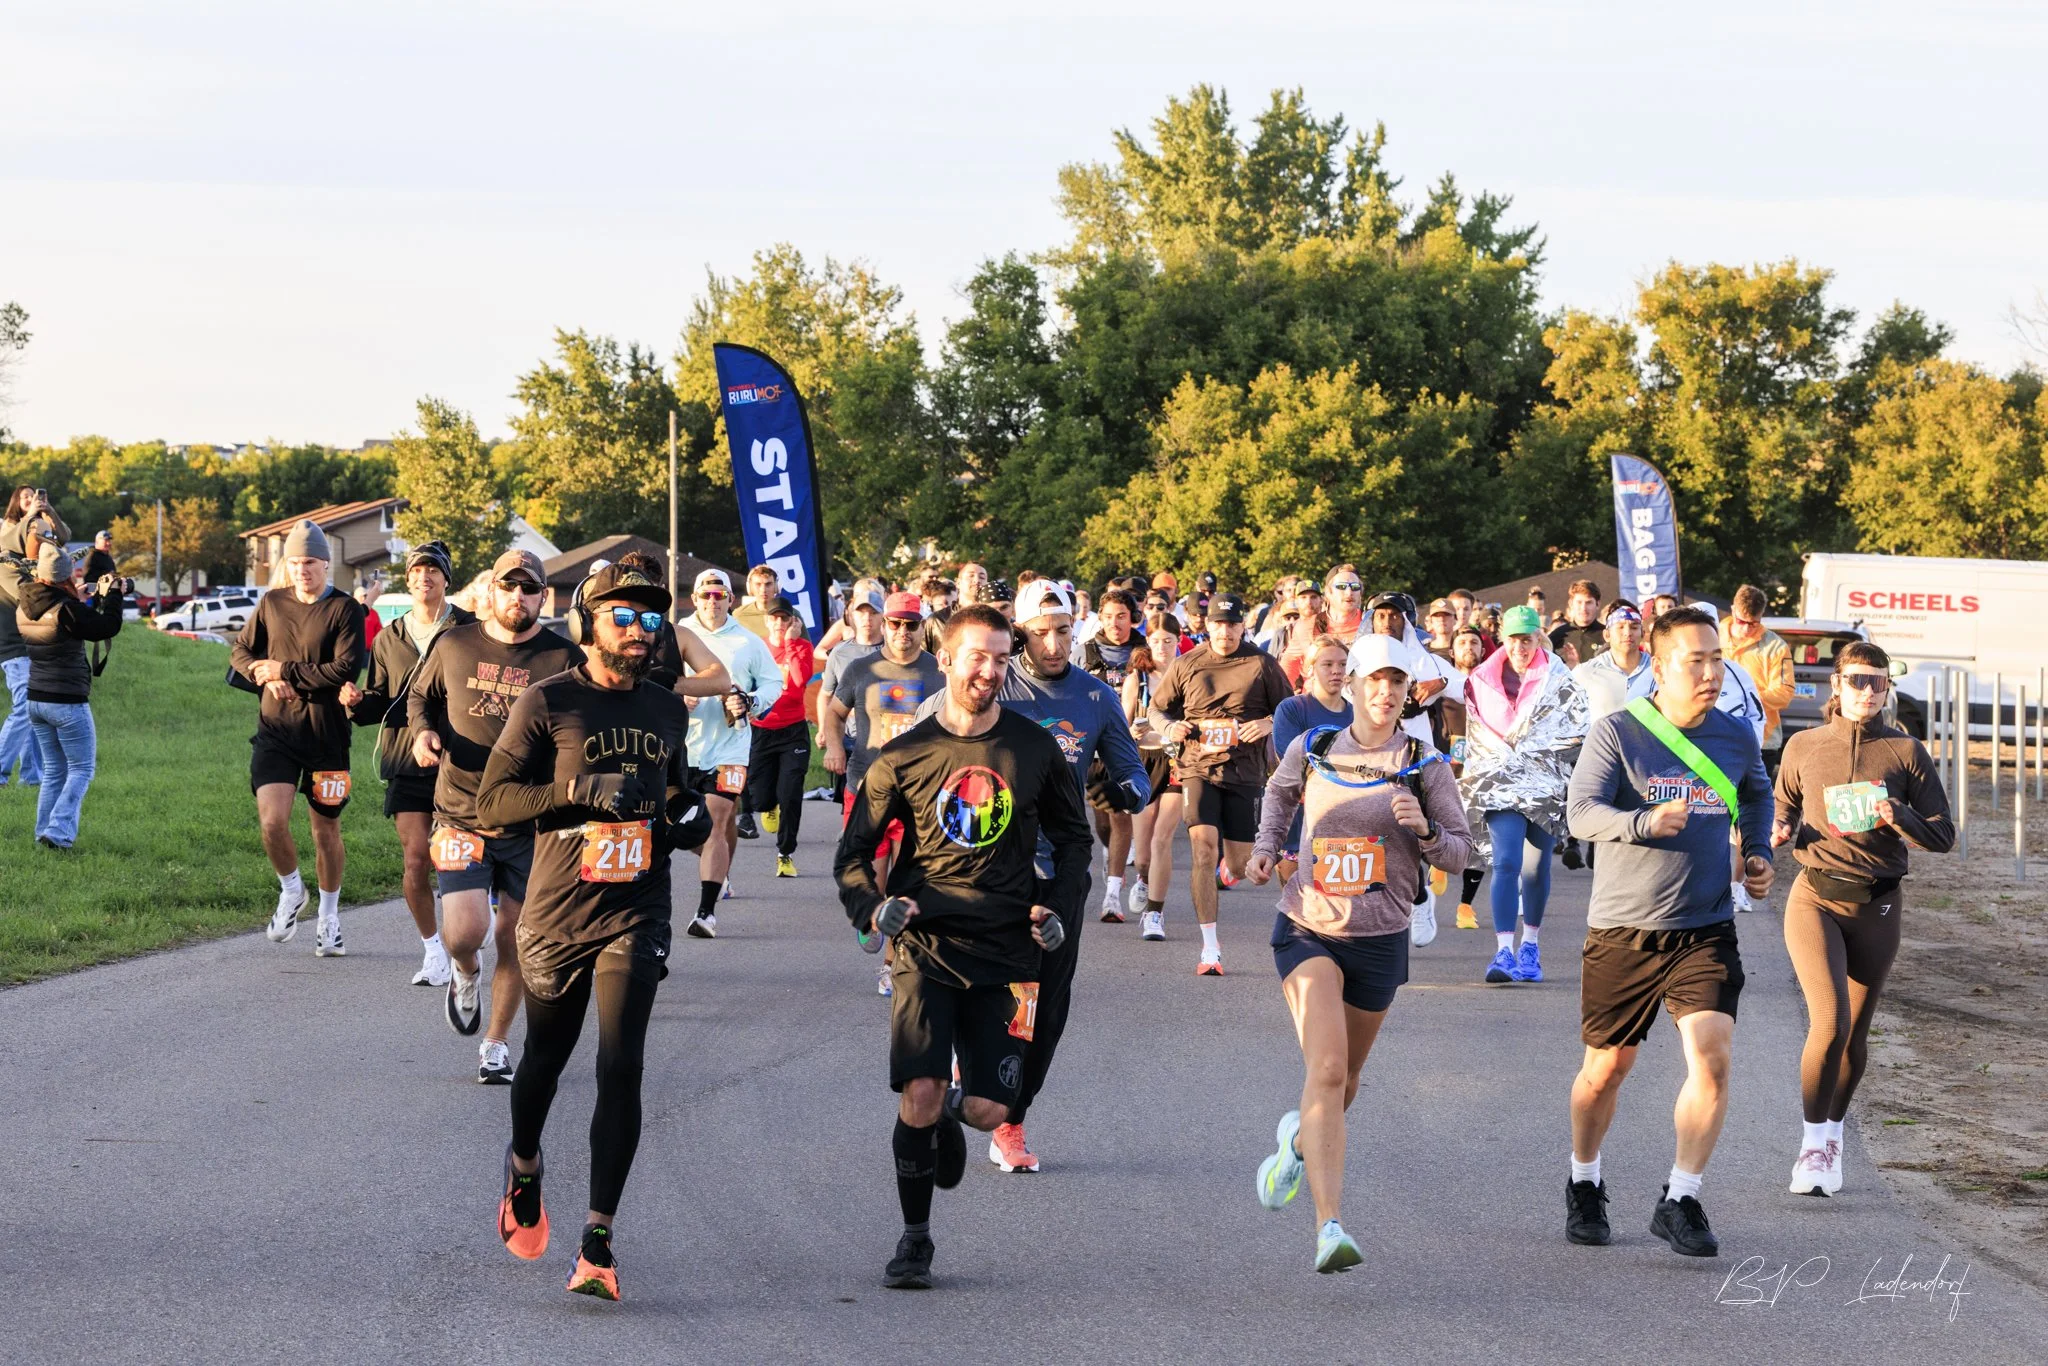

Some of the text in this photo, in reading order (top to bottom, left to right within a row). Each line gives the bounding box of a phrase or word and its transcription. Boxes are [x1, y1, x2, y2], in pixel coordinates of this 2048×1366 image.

[1632, 508, 1656, 569] BAG
[1848, 591, 1980, 613] SCHEELS
[477, 662, 500, 681] WE
[501, 666, 530, 687] ARE
[583, 727, 671, 770] CLUTCH
[1205, 728, 1232, 745] 237
[320, 780, 346, 798] 176
[725, 770, 744, 788] 147
[1648, 777, 1692, 786] SCHEELS
[1836, 794, 1881, 824] 314
[438, 838, 475, 861] 152
[596, 838, 643, 868] 214
[1324, 852, 1374, 883] 207
